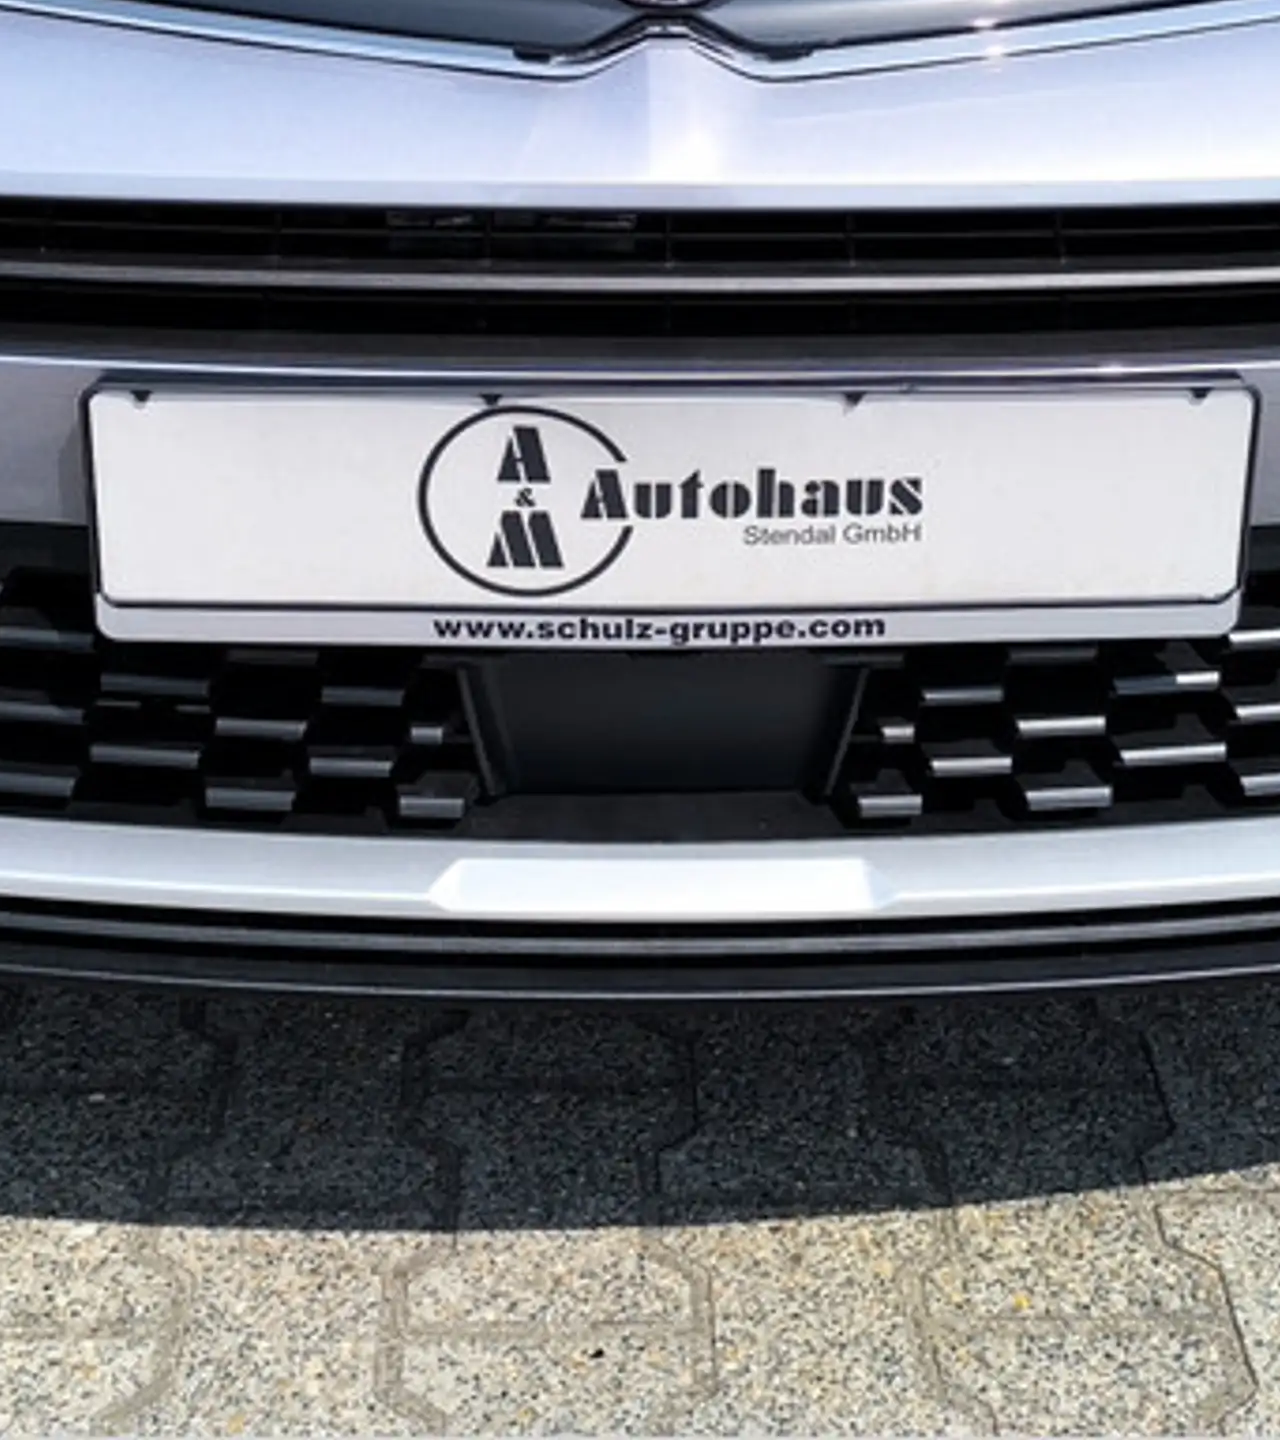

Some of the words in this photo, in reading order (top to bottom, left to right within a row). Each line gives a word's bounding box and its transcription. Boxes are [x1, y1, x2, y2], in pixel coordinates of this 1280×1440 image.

[497, 424, 551, 482] A
[515, 487, 536, 508] &
[580, 467, 924, 520] Autohaus
[486, 509, 565, 568] M
[743, 525, 836, 546] Stendal
[842, 522, 922, 545] GmbH
[433, 617, 887, 645] www.schulz-gruppe.com
